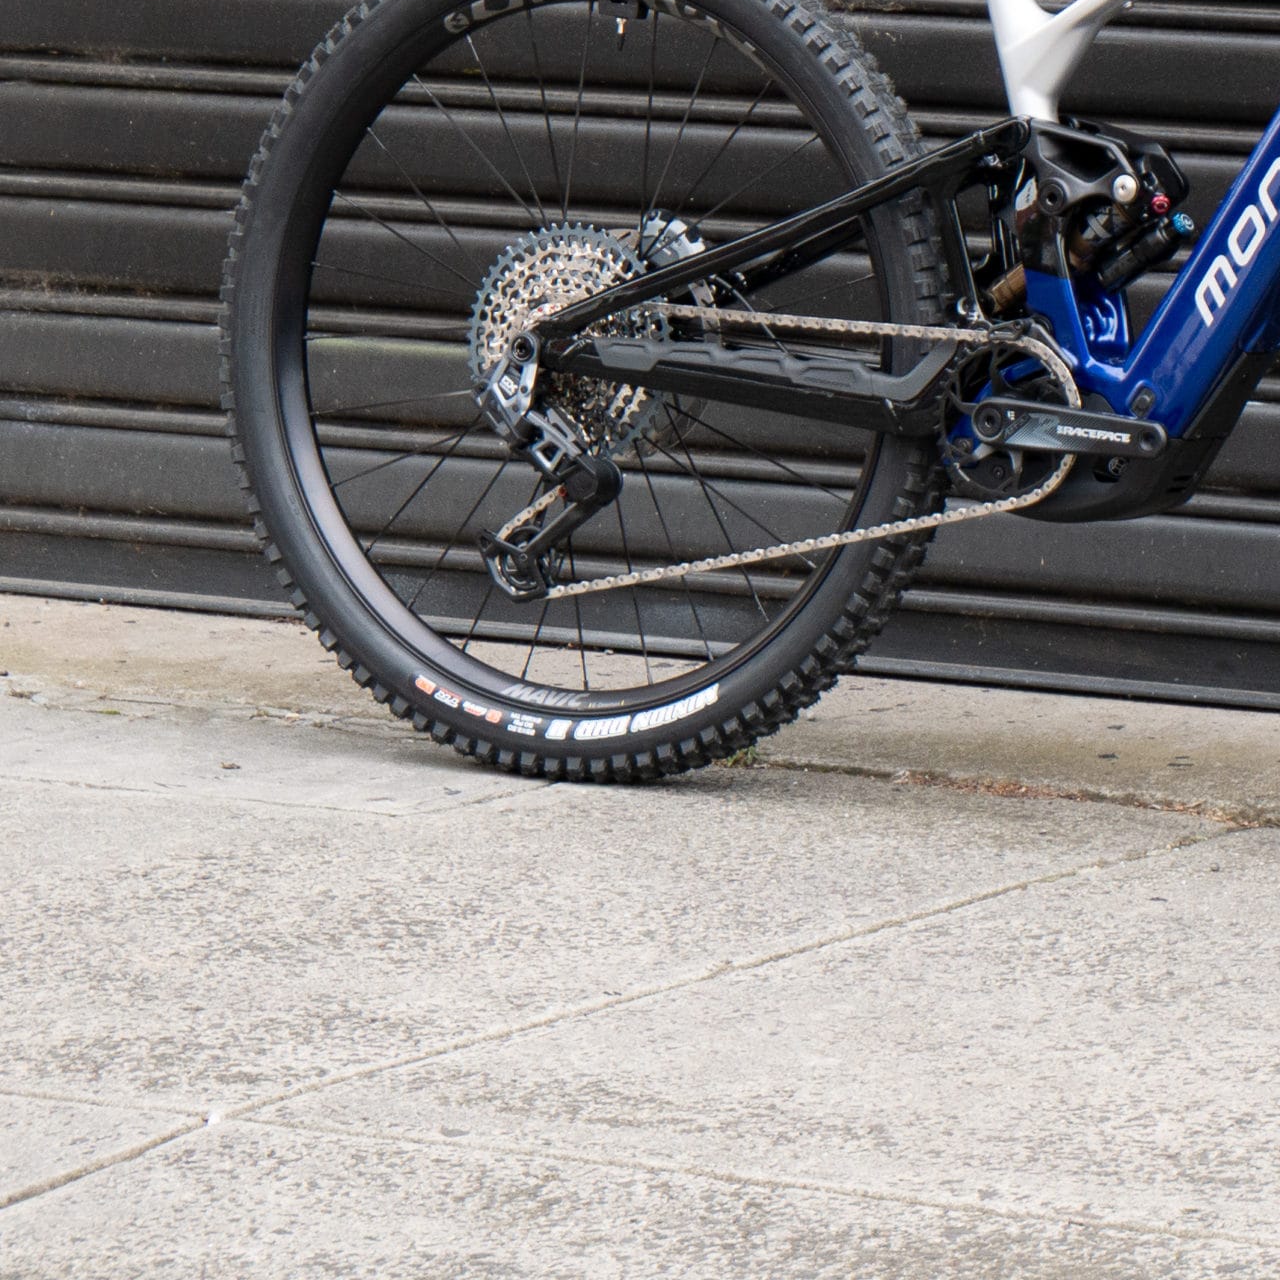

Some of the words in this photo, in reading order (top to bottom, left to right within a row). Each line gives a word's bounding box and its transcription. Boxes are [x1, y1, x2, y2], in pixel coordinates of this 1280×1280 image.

[1063, 425, 1131, 444] RACEFACE
[501, 683, 590, 711] MAVIC
[630, 682, 720, 734] MINION
